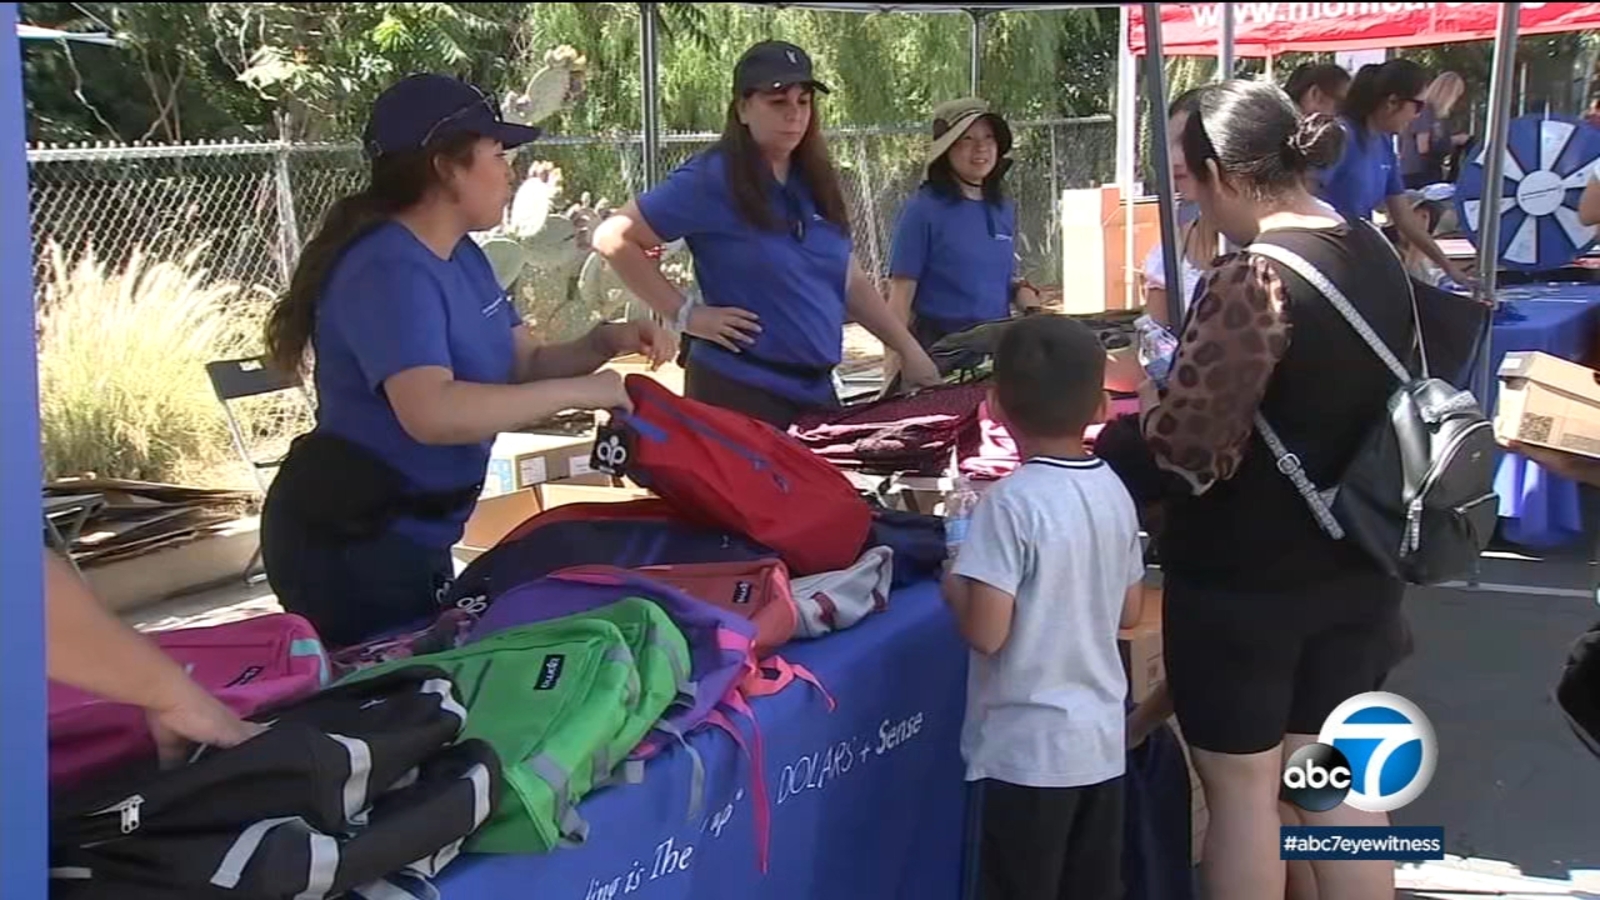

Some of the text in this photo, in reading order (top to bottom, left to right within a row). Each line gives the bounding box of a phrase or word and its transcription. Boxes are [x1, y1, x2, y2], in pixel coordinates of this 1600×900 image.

[624, 860, 646, 894] is
[649, 836, 694, 880] The
[874, 711, 924, 755] Sense
